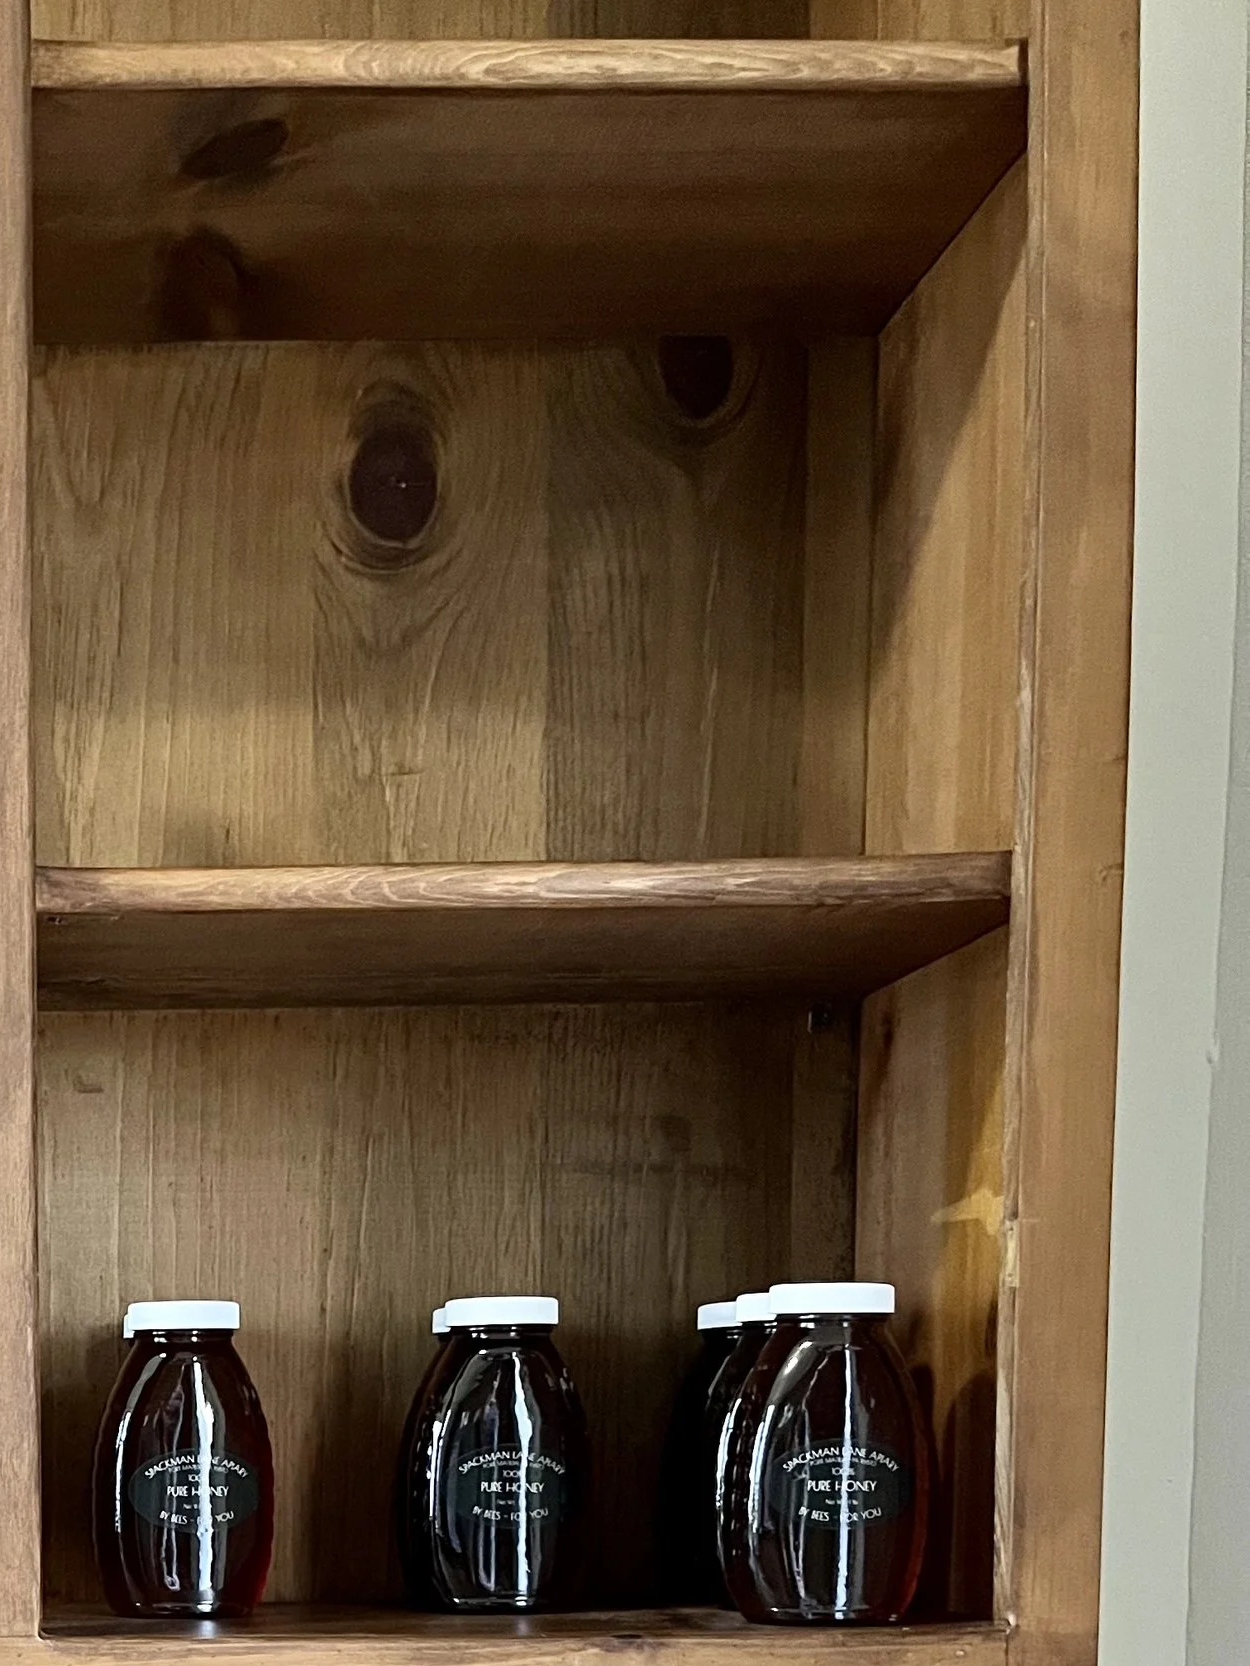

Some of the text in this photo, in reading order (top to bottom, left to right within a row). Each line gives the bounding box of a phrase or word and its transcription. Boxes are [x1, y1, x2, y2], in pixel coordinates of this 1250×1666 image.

[458, 1451, 510, 1475] SPACKMAN
[782, 1446, 839, 1473] SPACKMAN
[144, 1455, 195, 1479] SPACKMAN
[167, 1486, 188, 1497] PURE
[480, 1482, 502, 1493] PURE
[807, 1480, 877, 1491] PURE HONEY
[215, 1510, 235, 1523] YOU
[529, 1507, 549, 1518] YOU
[810, 1509, 829, 1521] BEES
[860, 1507, 881, 1519] YOU
